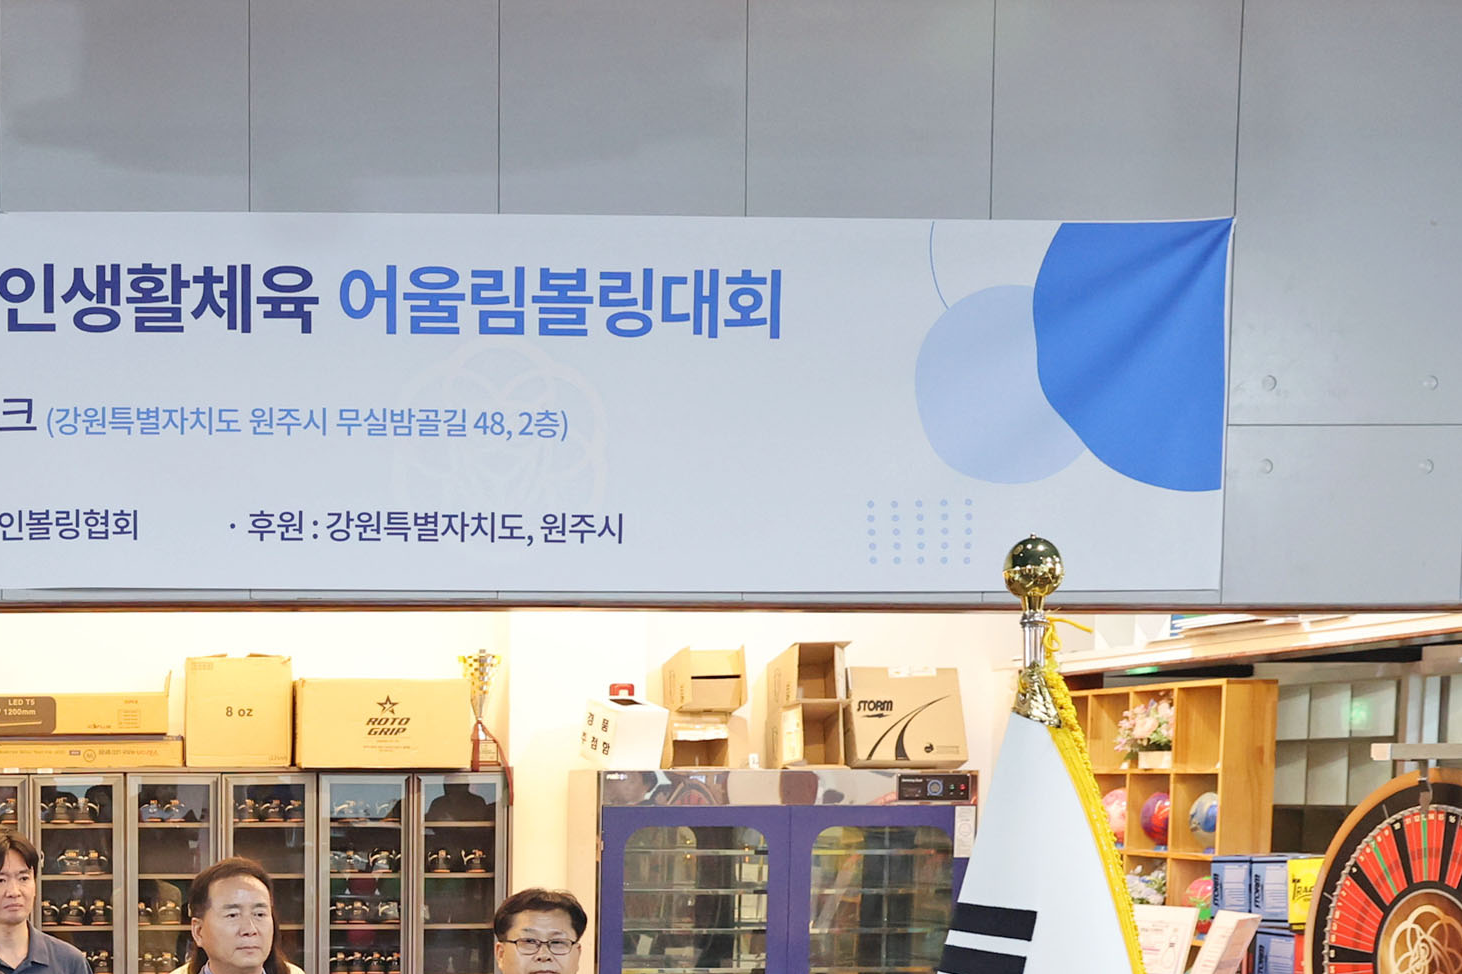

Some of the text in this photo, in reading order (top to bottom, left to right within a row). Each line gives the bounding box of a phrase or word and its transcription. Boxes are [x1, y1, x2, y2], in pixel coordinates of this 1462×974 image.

[339, 264, 783, 340] 어울림볼링대회
[45, 406, 242, 439] (강원특별자치도
[249, 407, 327, 437] 원주시
[336, 407, 467, 438] 무실밤골길
[473, 411, 513, 441] 48,
[518, 409, 569, 442] 2층)
[247, 509, 304, 542] 후원
[326, 510, 534, 547] 강원특별자치도,
[540, 512, 623, 545] 원주시
[3, 708, 36, 716] 1200mm
[226, 706, 254, 718] 8 oz
[856, 700, 894, 712] STORM
[365, 717, 411, 726] ROTO
[367, 727, 408, 737] GRIP
